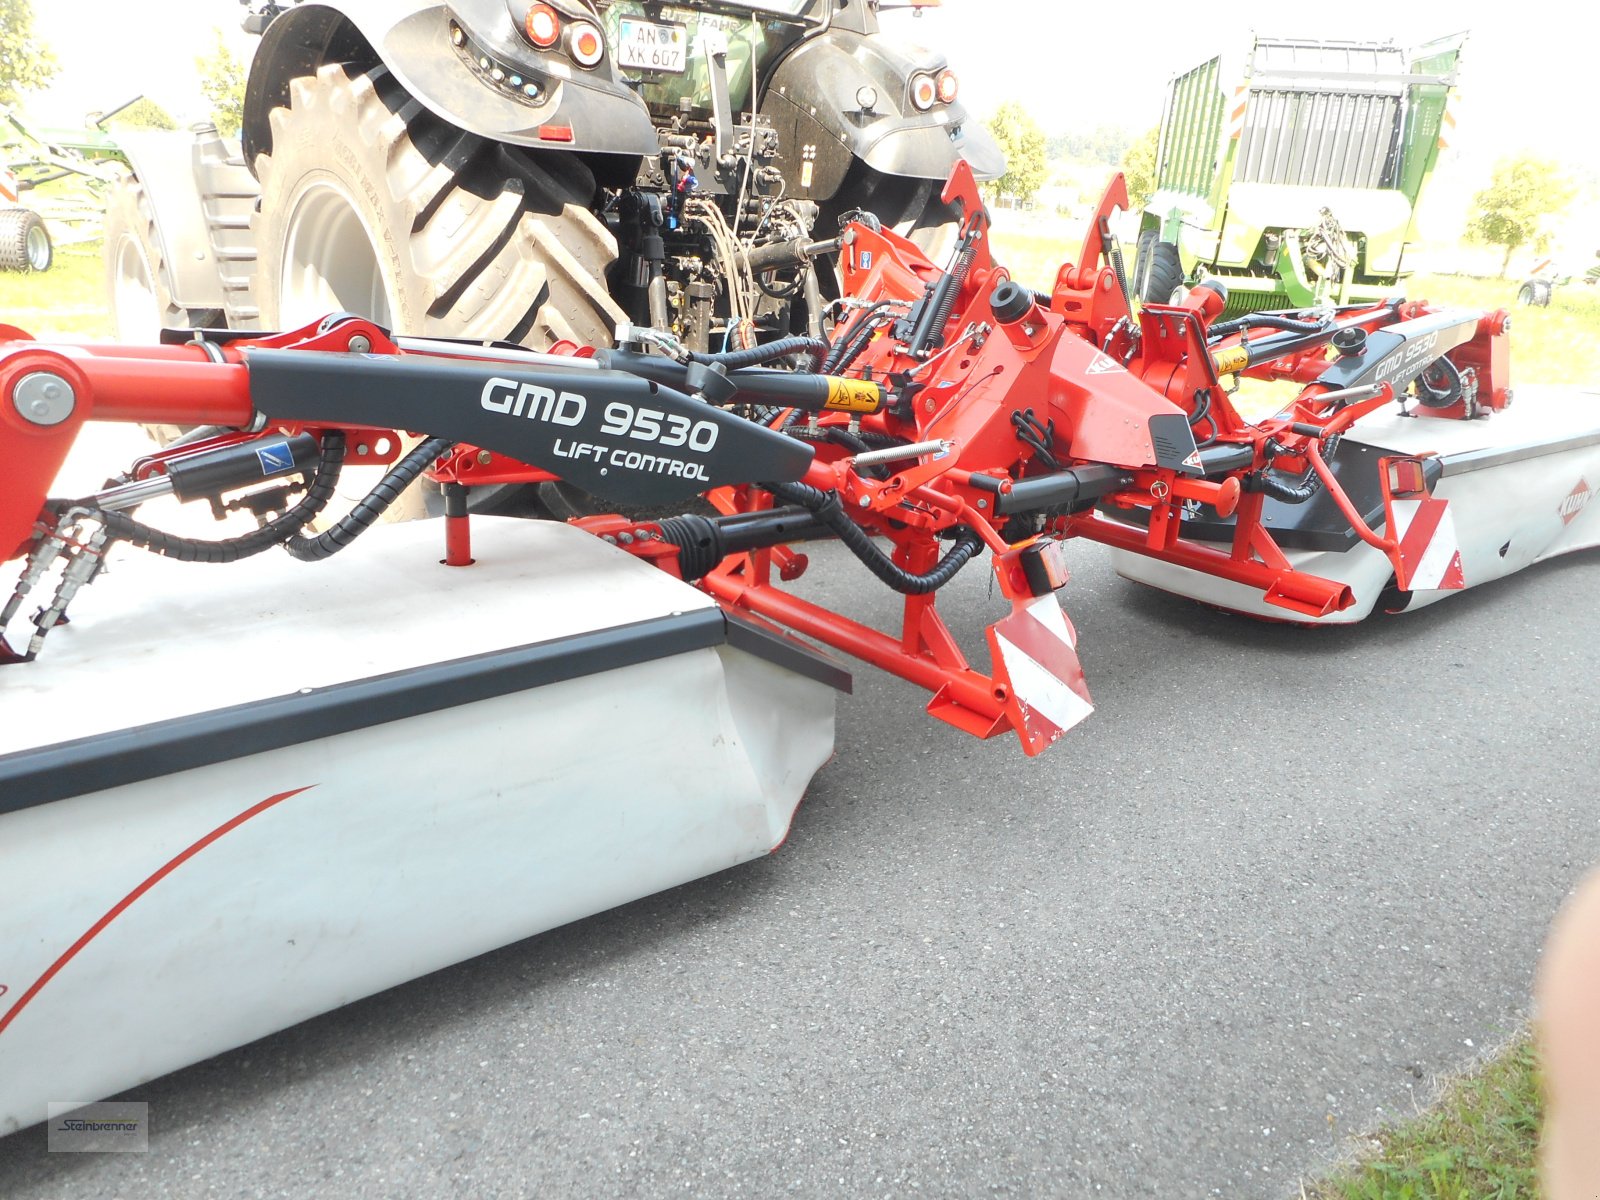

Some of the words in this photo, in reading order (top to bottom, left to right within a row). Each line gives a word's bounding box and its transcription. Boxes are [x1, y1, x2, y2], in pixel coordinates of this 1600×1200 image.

[637, 26, 656, 45] AN
[659, 7, 740, 33] EUTZ-FAHR
[627, 44, 646, 64] XK
[652, 49, 680, 67] 607
[1375, 351, 1403, 381] GMD
[1405, 329, 1439, 363] 9530
[1391, 368, 1406, 385] LIFT
[1405, 353, 1435, 376] CONTROL
[480, 376, 587, 427] GMD
[600, 401, 719, 453] 9530
[553, 438, 608, 463] LIFT
[609, 449, 711, 482] CONTROL
